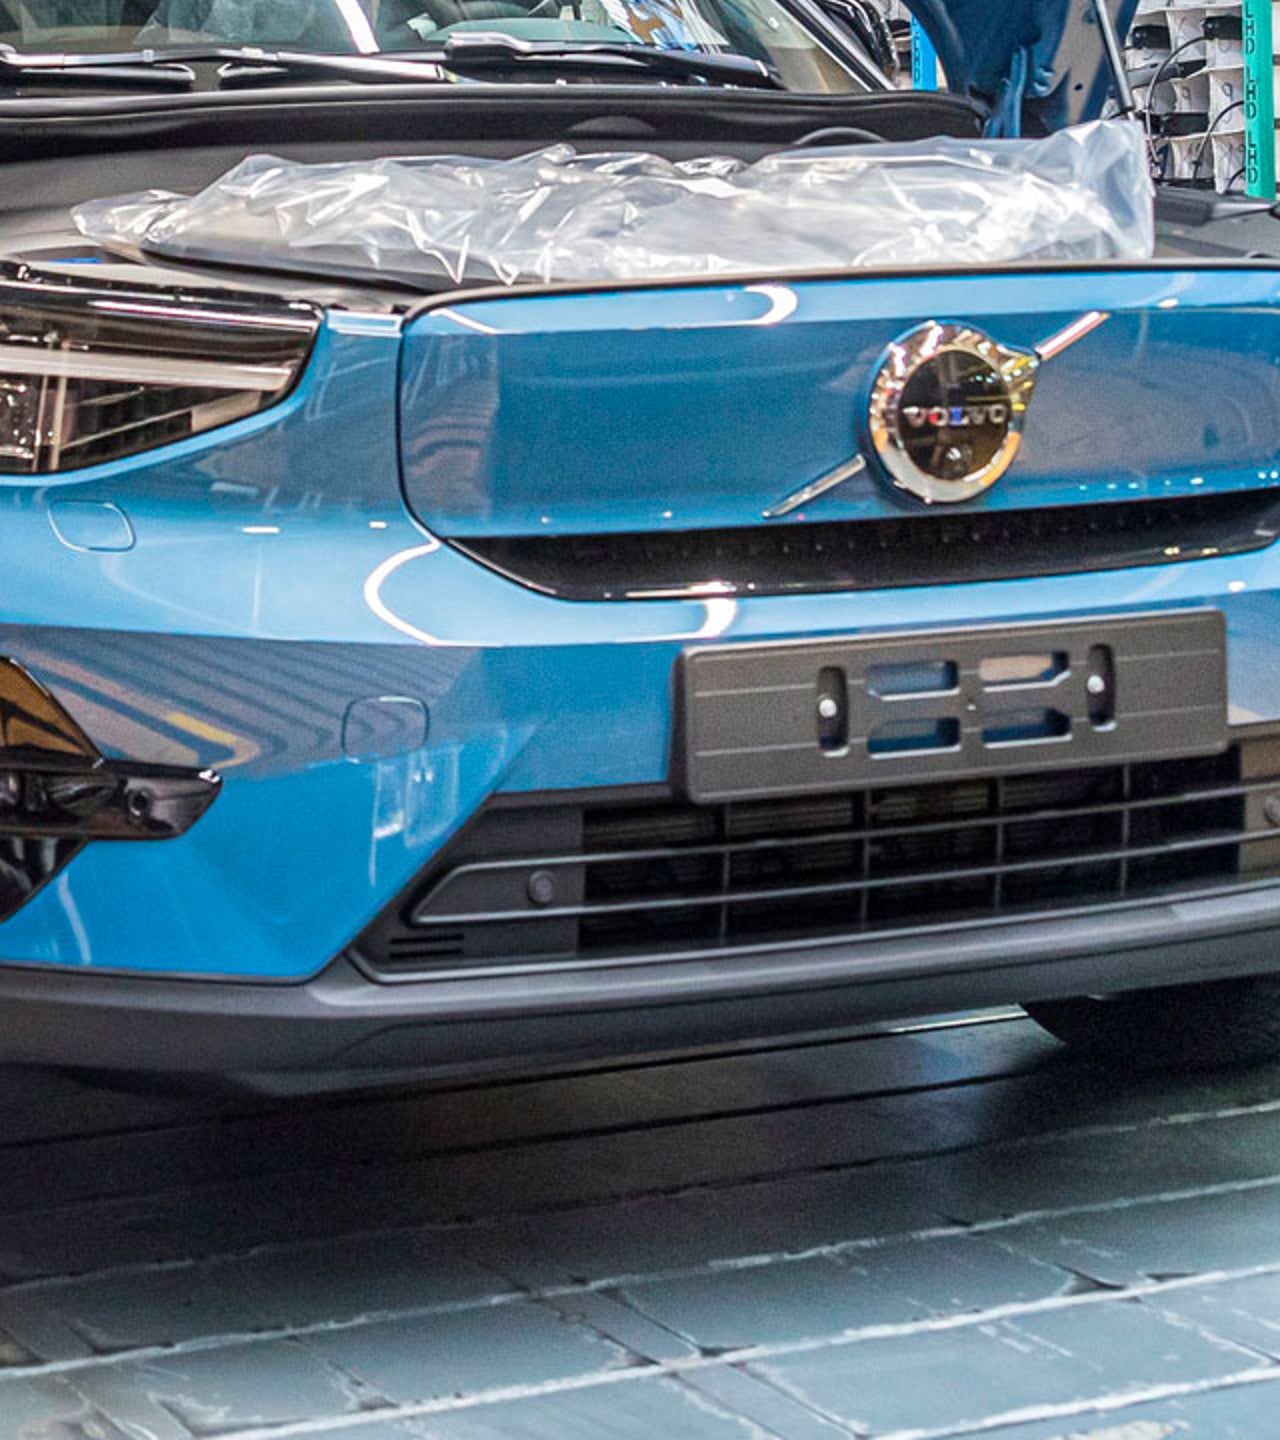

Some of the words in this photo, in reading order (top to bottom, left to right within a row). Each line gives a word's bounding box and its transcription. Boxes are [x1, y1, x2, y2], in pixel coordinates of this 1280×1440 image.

[1244, 2, 1256, 54] LHD
[1245, 66, 1257, 119] LHD
[1247, 132, 1259, 185] LHD
[903, 403, 1007, 427] VOLVO
